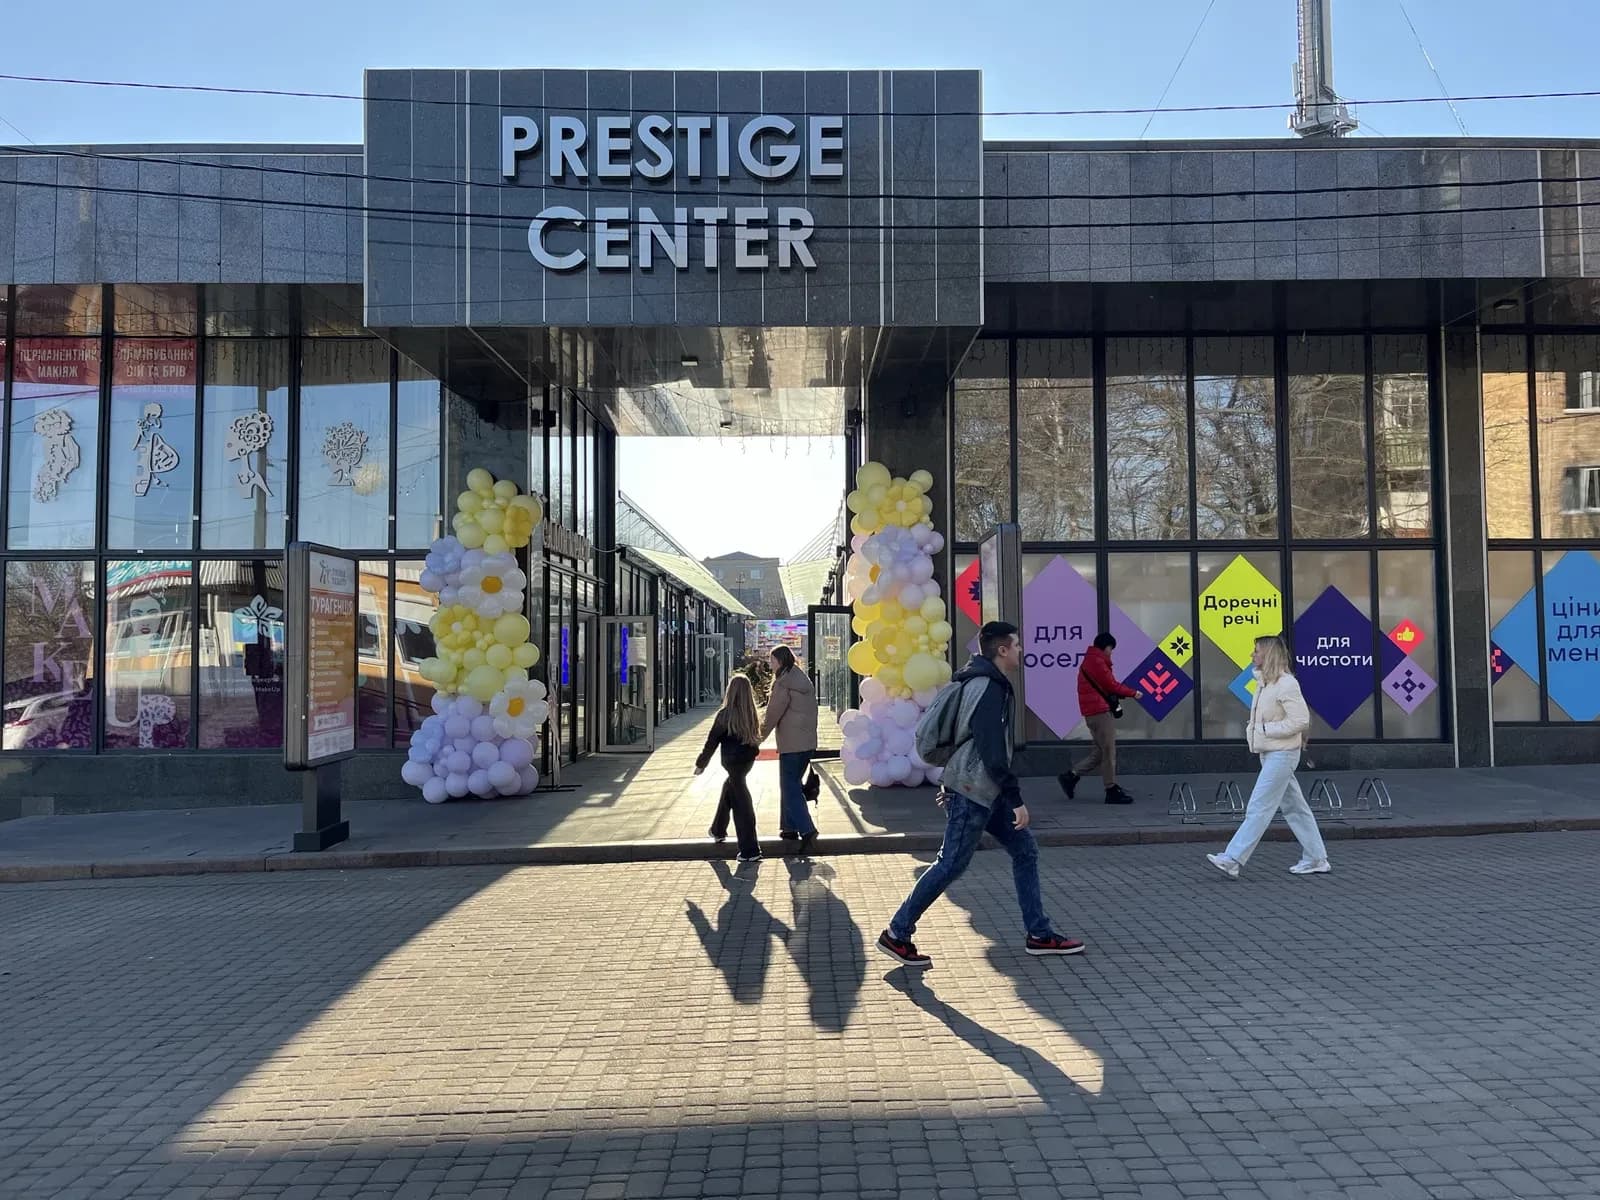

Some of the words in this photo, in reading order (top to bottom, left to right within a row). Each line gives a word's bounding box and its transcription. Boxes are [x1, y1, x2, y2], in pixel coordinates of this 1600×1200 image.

[501, 114, 845, 180] PRESTIGE
[527, 205, 818, 271] CENTER
[37, 364, 79, 378] МАКІЯЖ
[162, 364, 187, 377] БРІВ
[1203, 594, 1278, 611] Доречні
[1223, 611, 1260, 628] речі
[1034, 625, 1083, 644] для
[1557, 624, 1600, 642] для
[1316, 636, 1351, 650] для
[1023, 653, 1087, 668] осел
[1295, 654, 1373, 667] чистоти
